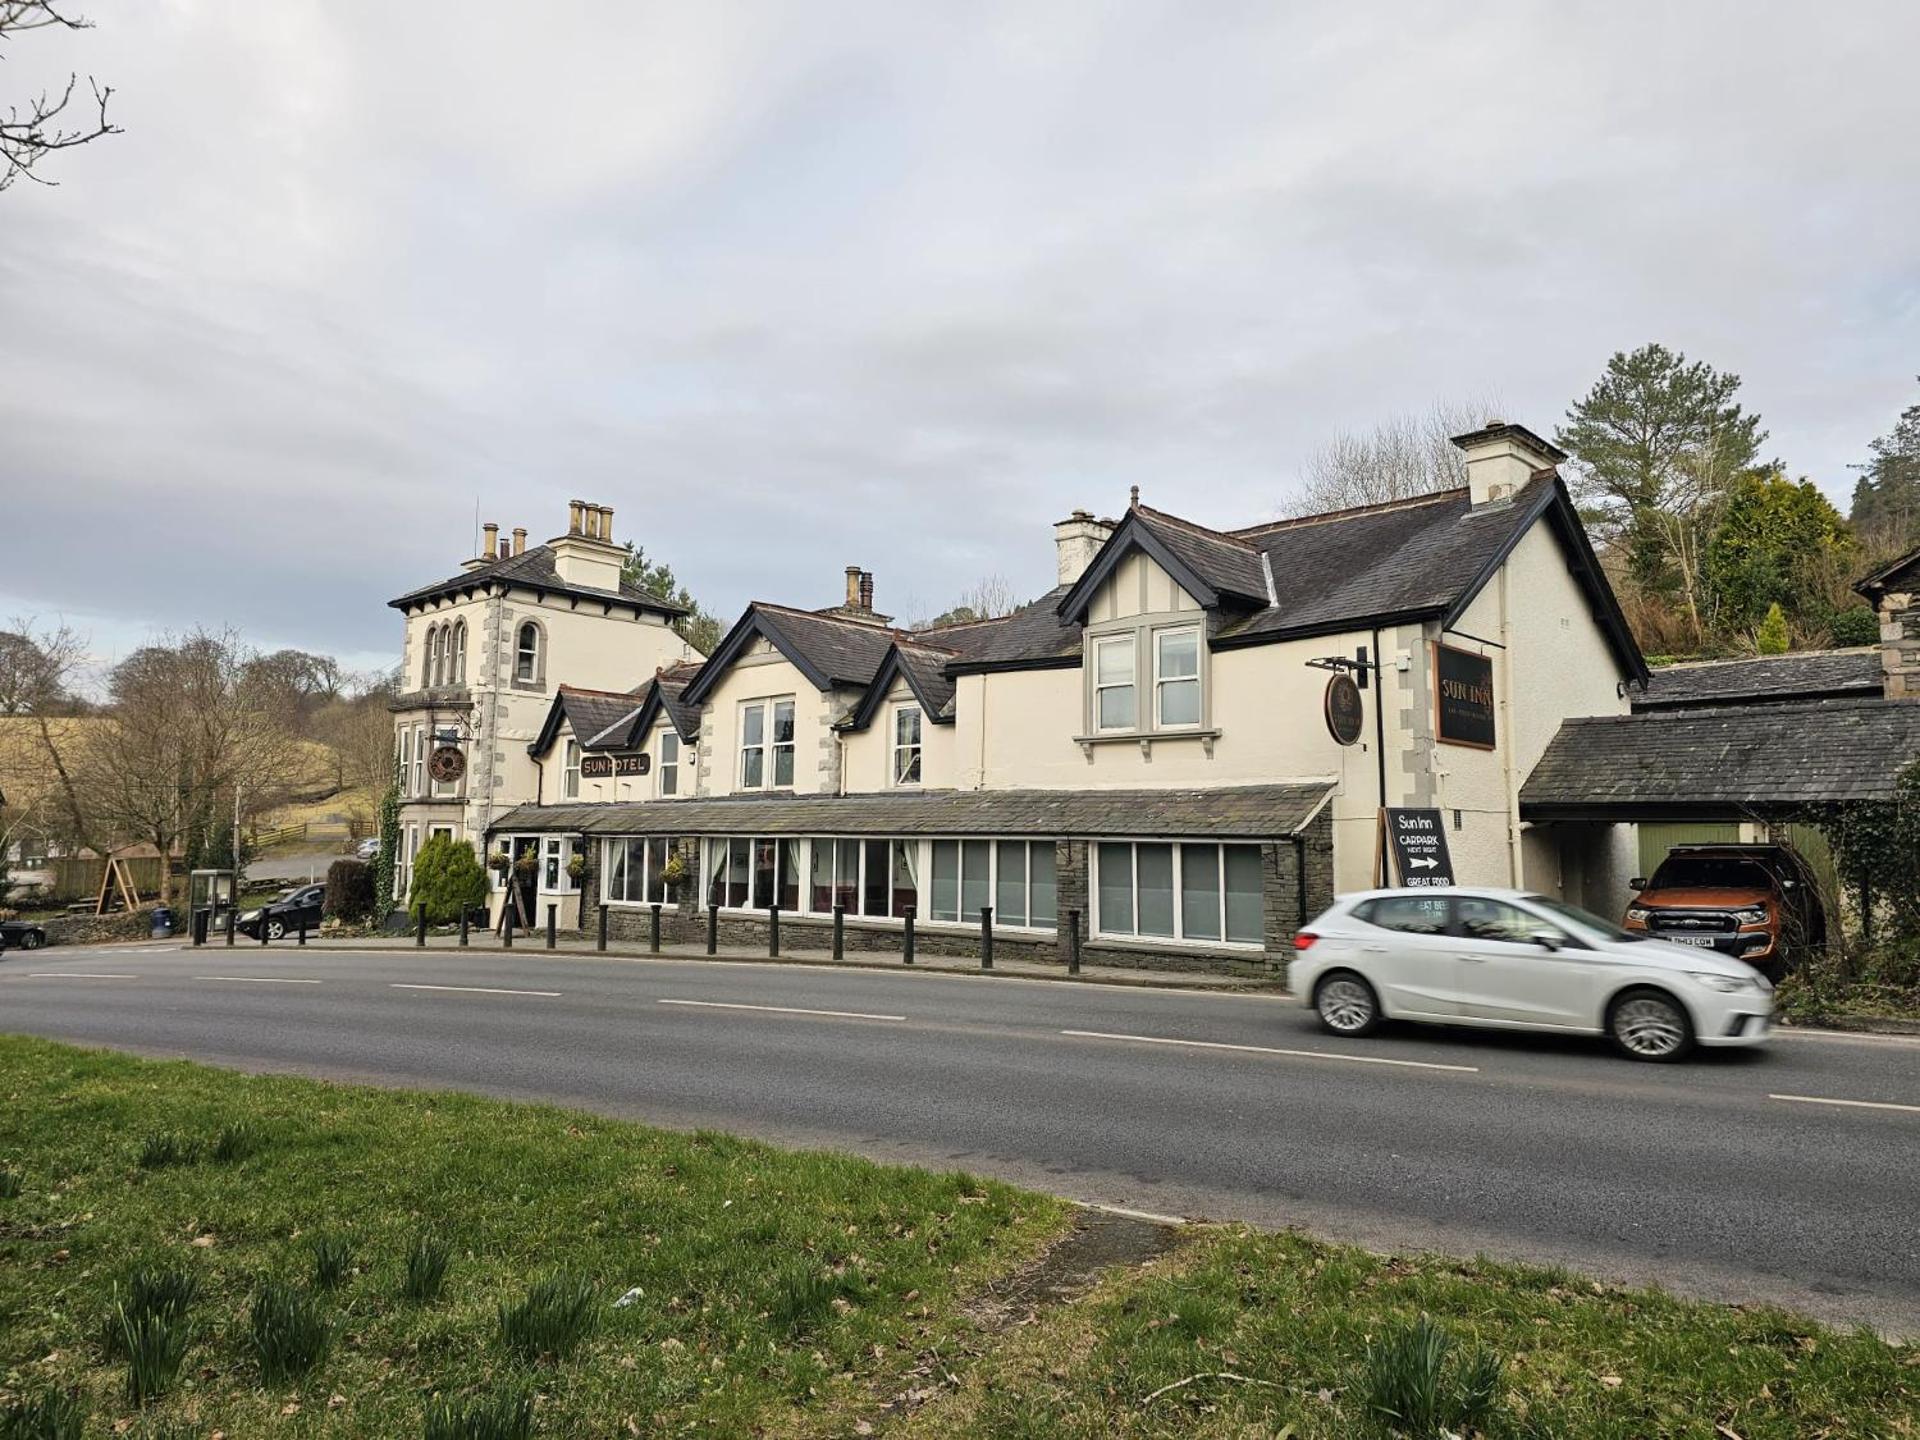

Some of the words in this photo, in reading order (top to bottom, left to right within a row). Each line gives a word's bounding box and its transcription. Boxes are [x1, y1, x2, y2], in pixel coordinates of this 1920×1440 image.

[1442, 679, 1466, 700] SUN
[1470, 685, 1490, 707] INN
[584, 760, 606, 773] SUN
[608, 758, 644, 770] HOTEL
[1398, 814, 1418, 829] Sun
[1417, 815, 1433, 829] Inn
[1406, 877, 1431, 887] GREAT
[1431, 877, 1450, 888] FOOD
